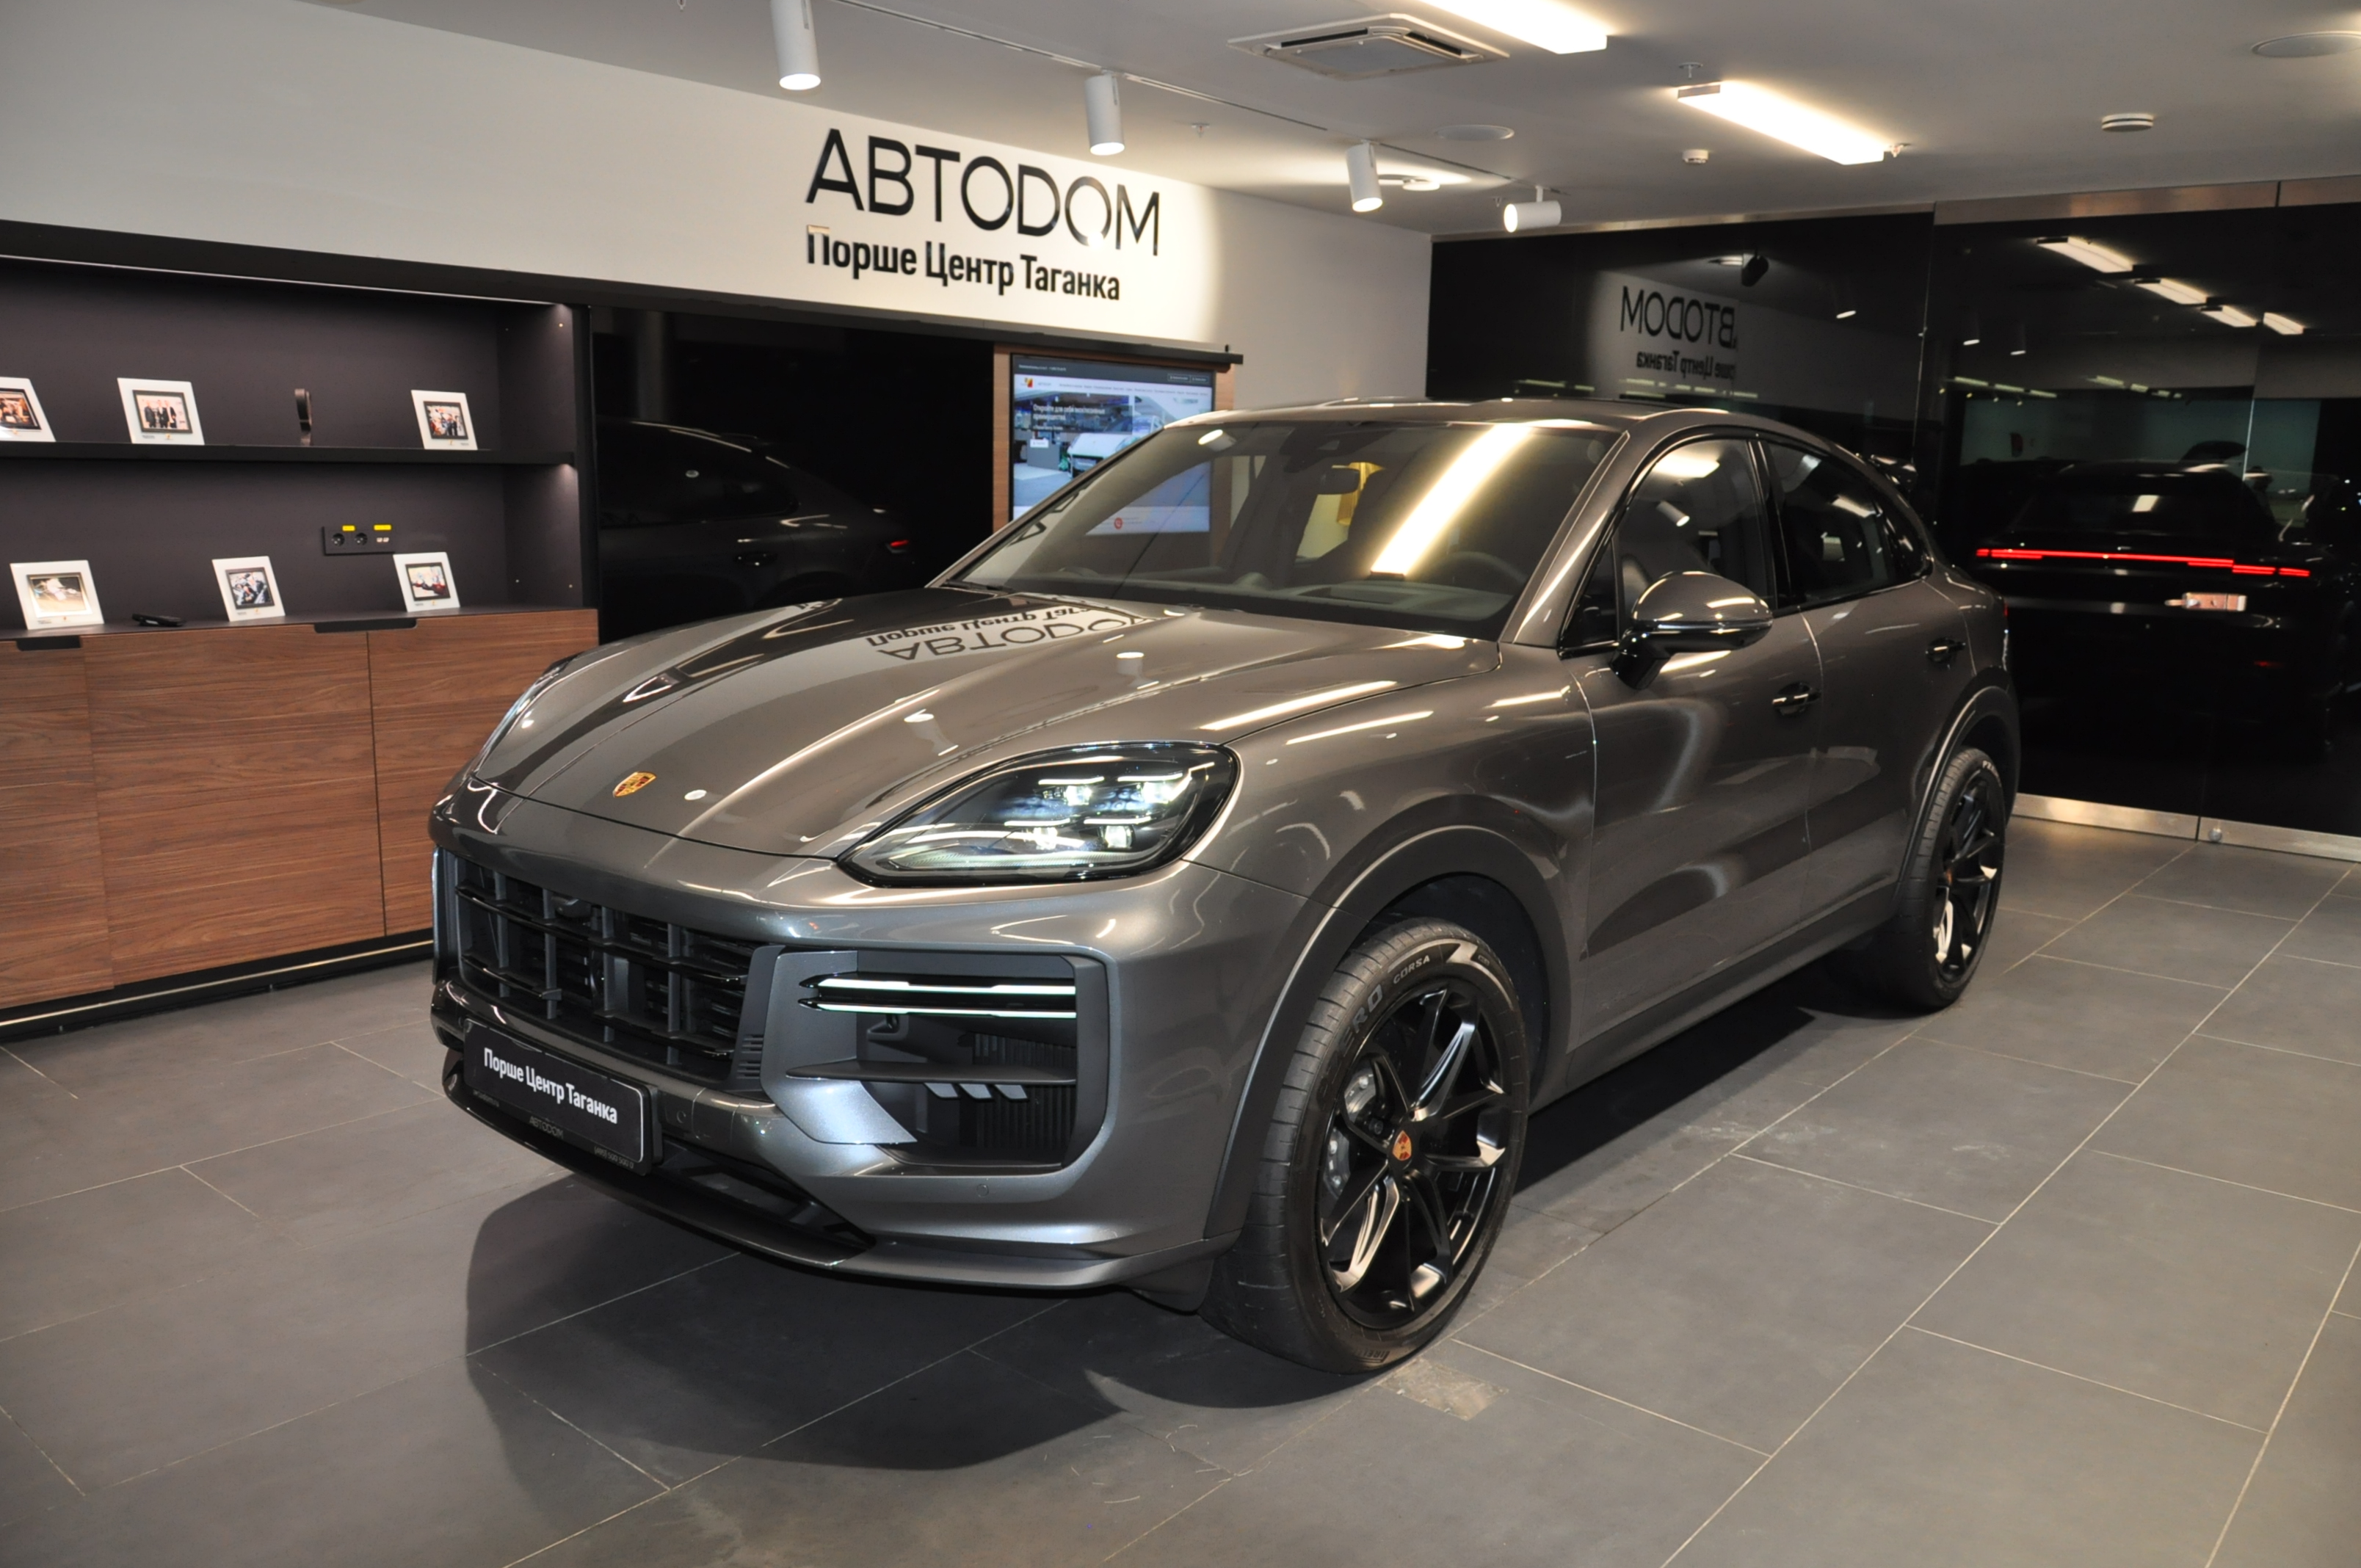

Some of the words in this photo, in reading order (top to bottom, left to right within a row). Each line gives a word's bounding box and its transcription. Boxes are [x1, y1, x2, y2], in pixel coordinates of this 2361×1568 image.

[807, 225, 917, 280] Порше
[925, 241, 1015, 295] Центр
[1020, 254, 1120, 300] Таганка
[1393, 955, 1430, 984] CORSA
[484, 1048, 524, 1082] Порше
[526, 1066, 565, 1104] Центр
[565, 1083, 618, 1124] Таганка
